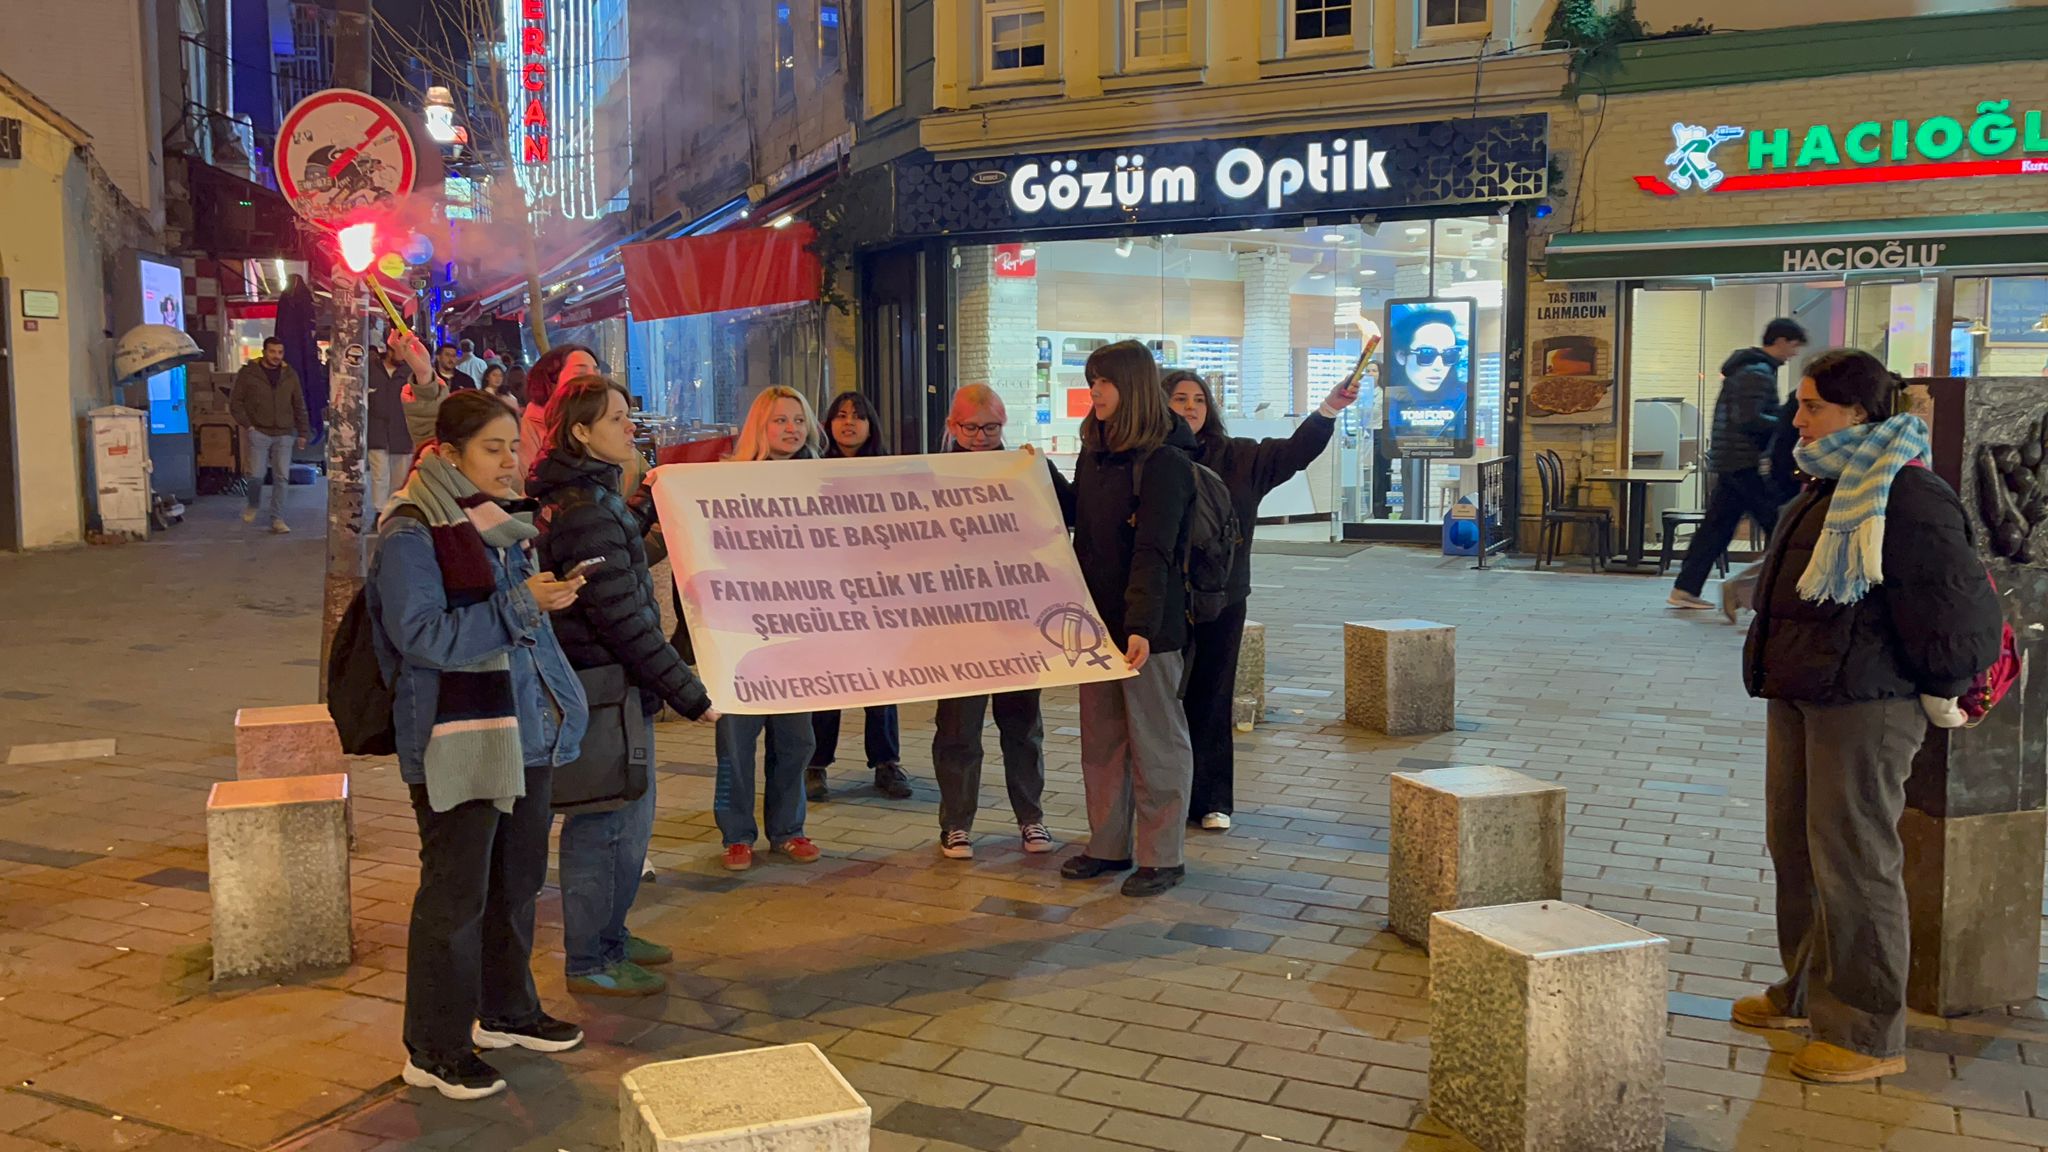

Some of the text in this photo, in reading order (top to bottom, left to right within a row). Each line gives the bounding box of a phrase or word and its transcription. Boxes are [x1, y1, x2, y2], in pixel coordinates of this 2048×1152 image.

[1010, 138, 1390, 212] Gözüm Optik
[1537, 305, 1606, 320] LAHMACUN
[1548, 291, 1597, 306] TAŞ FIRIN
[696, 484, 1015, 520] TARİKATLARINIZI DA, KUTSAL
[713, 512, 1021, 551] AİLENİZİ DE BAŞINIZA ÇALIN!
[710, 560, 1051, 606] FATMANUR ÇELİK VE HİFA İKRA
[752, 607, 871, 642] ŞENGÜLER
[872, 597, 1029, 630] İSYANIMIZDIR!
[734, 650, 1053, 703] ÜNİVERSİTELİ KADIN KOLEKTİFİ
